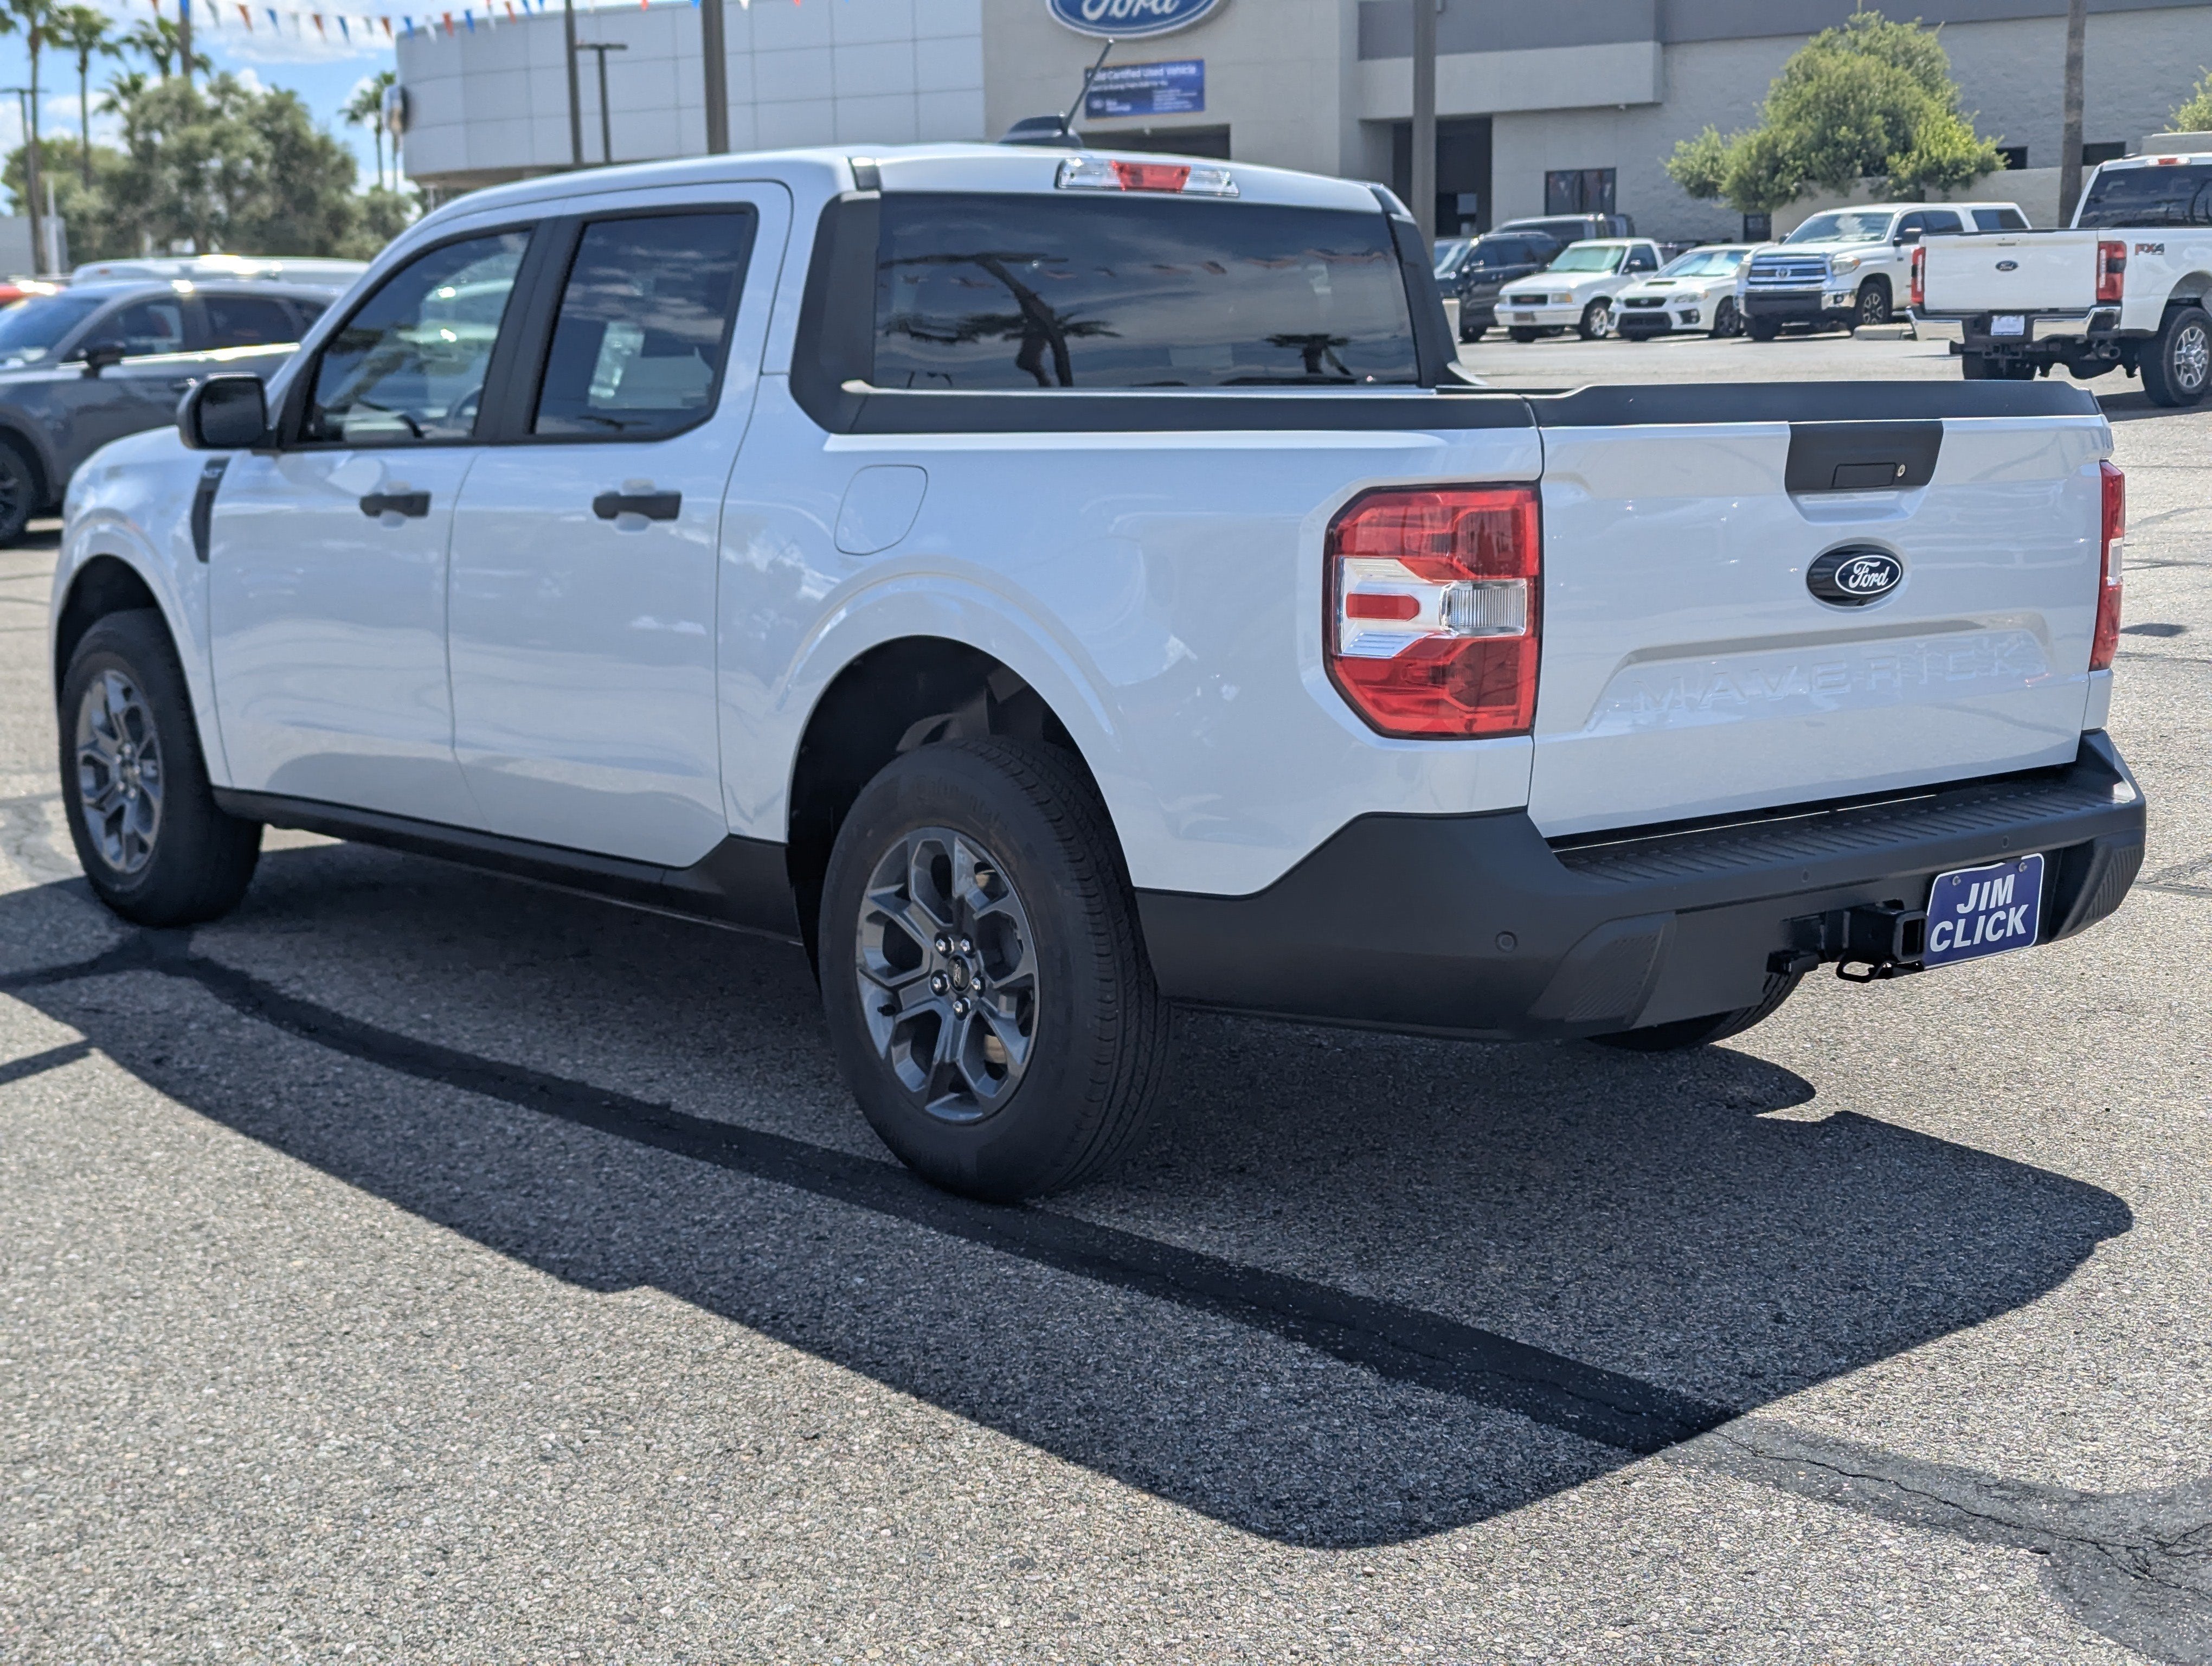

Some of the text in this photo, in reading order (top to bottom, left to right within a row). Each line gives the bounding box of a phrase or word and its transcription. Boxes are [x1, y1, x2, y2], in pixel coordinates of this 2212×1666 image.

[2135, 243, 2165, 255] FX4
[1848, 561, 1891, 588] Ford
[1631, 640, 2024, 713] MAVERICK
[1957, 874, 2015, 914] JIM
[1930, 904, 2029, 952] CLICK
